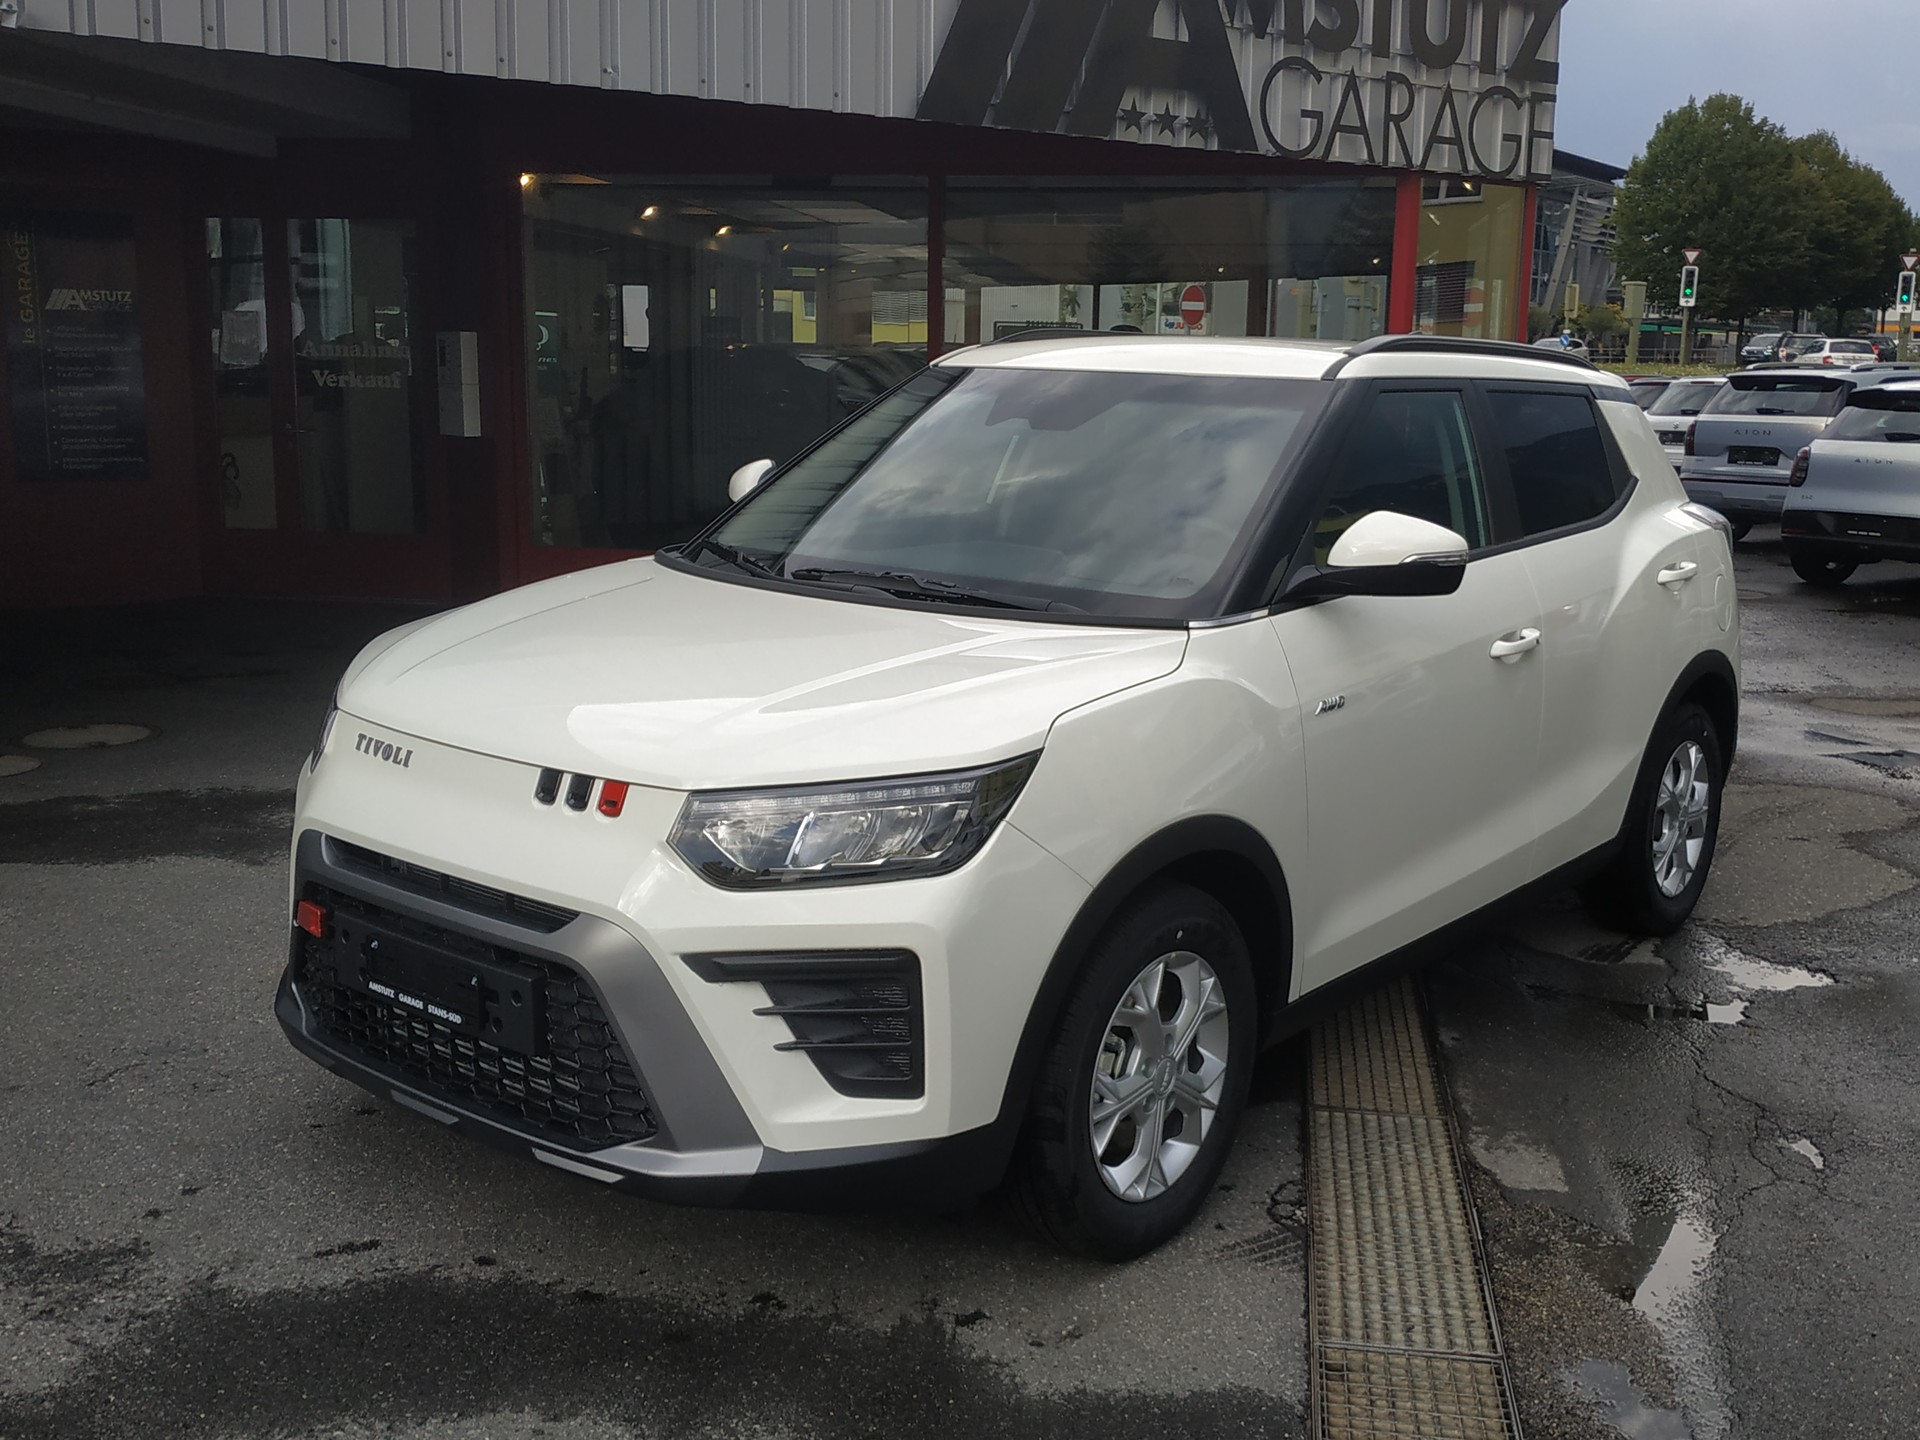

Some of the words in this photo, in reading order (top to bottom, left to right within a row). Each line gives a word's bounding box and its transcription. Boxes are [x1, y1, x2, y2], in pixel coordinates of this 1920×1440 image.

[1258, 56, 1557, 182] GARAGE
[15, 231, 34, 323] GARAGE
[60, 288, 133, 311] AMSTUTZ
[312, 369, 401, 388] Verkauf
[1314, 695, 1346, 716] AWD
[355, 732, 414, 769] TIVOLI
[368, 981, 395, 999] AMSTUTZ
[398, 993, 424, 1009] GARAGE
